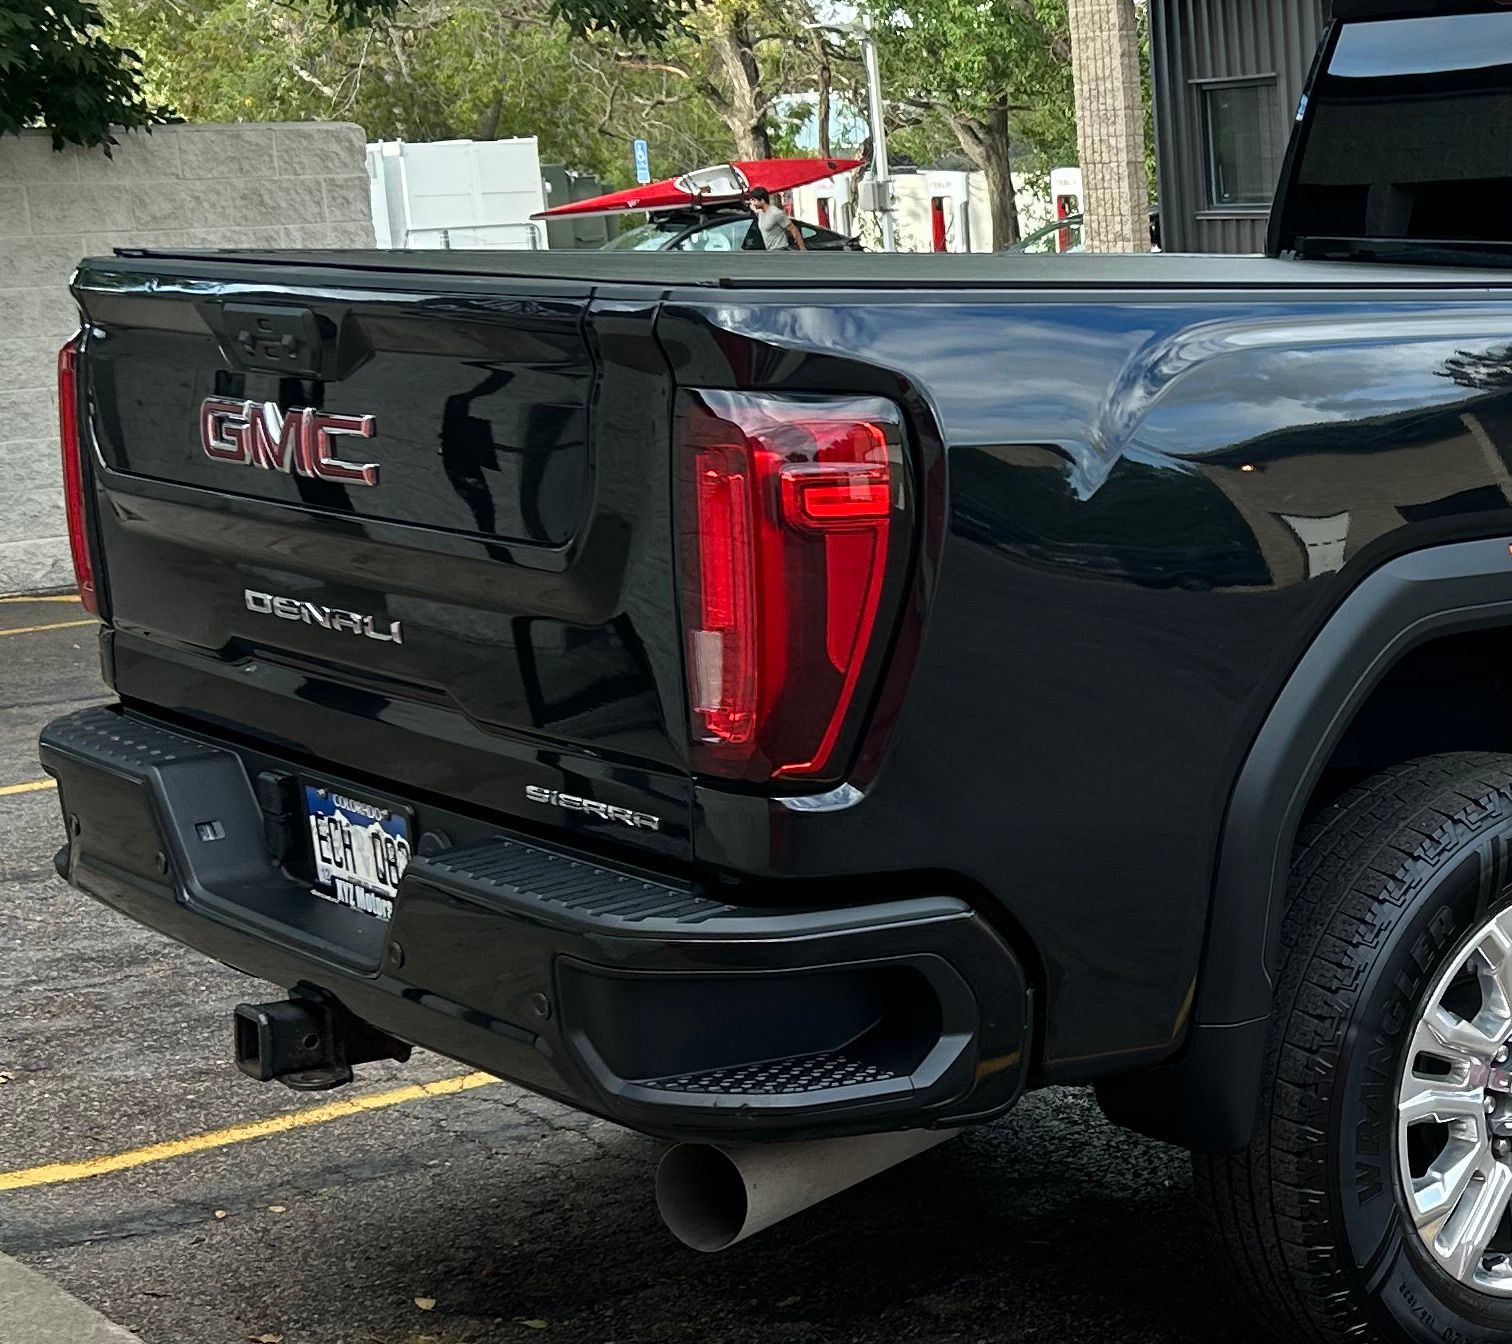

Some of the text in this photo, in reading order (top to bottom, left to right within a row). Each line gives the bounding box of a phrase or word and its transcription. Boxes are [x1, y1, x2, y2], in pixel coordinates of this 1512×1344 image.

[201, 395, 380, 486] GMC
[244, 589, 403, 645] DENALI
[525, 785, 660, 831] SIERRA
[315, 812, 358, 875] ECH
[1356, 905, 1456, 1206] WRANGLER
